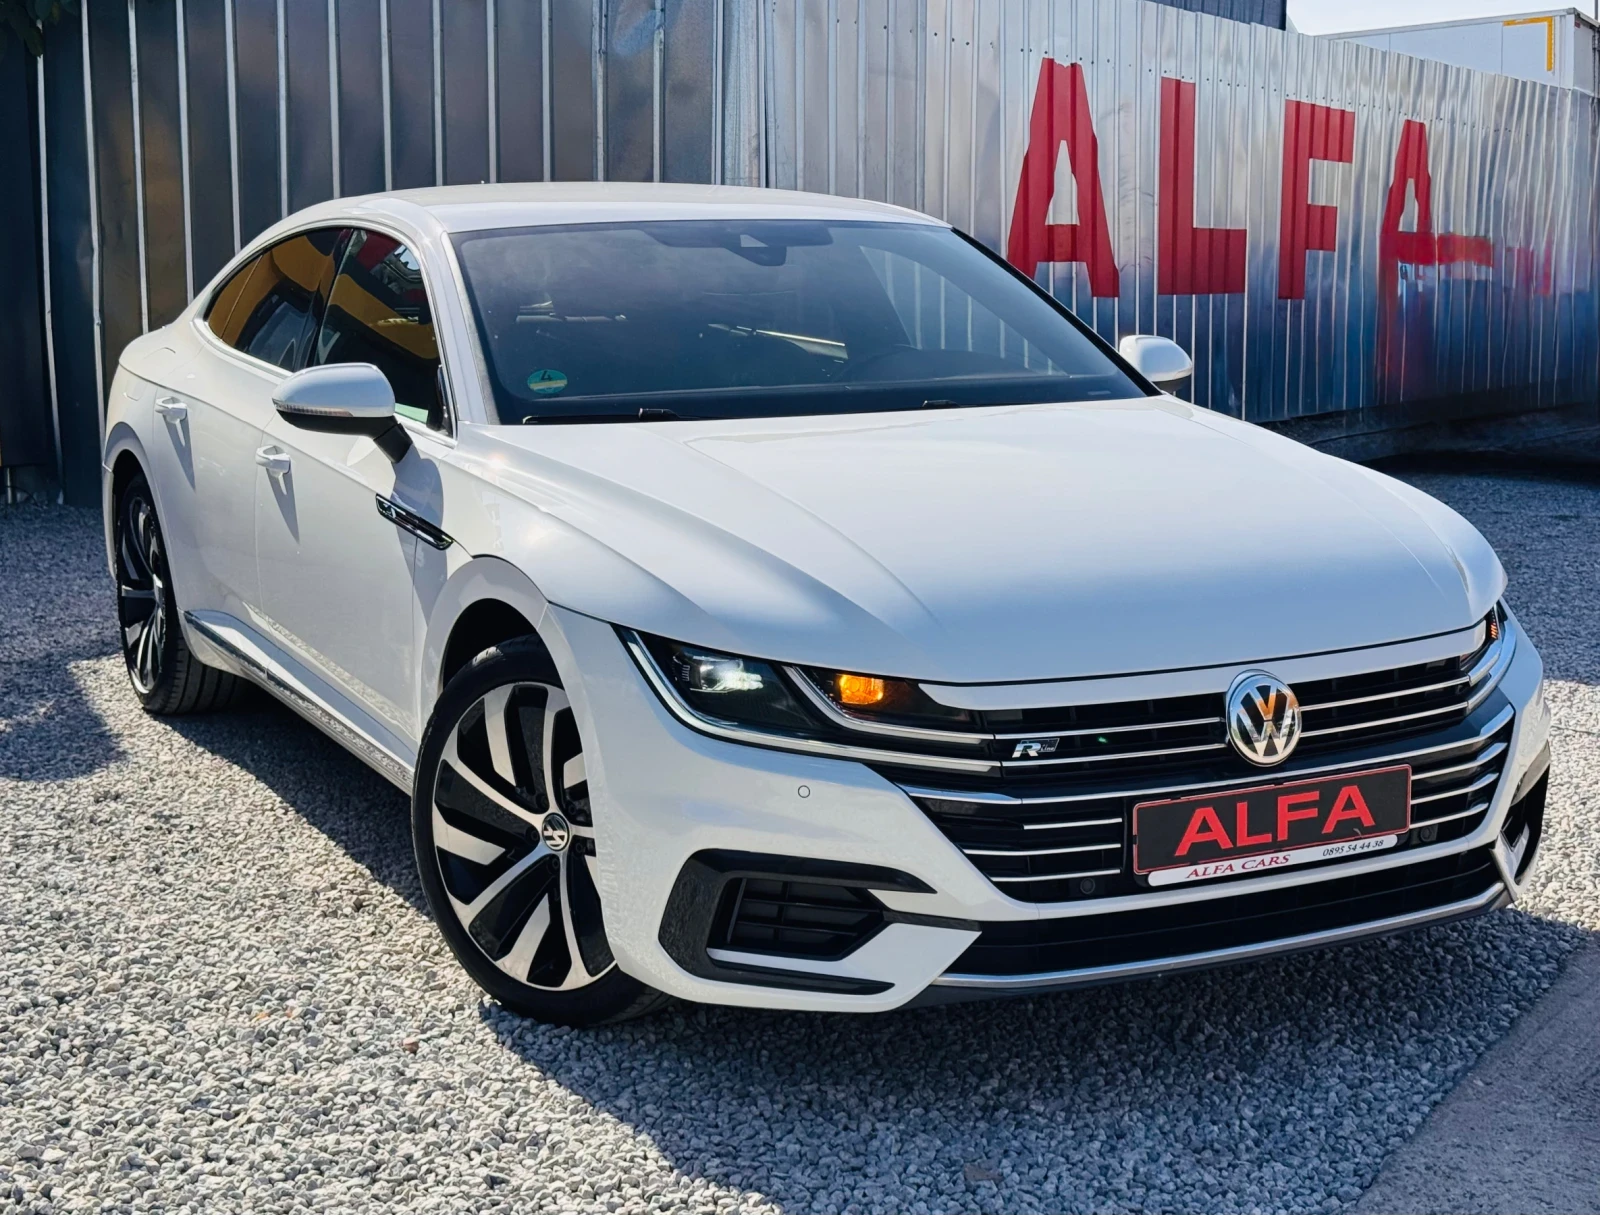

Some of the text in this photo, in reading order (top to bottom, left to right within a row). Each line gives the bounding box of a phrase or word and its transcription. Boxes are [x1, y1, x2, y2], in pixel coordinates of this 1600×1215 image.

[1007, 57, 1440, 300] ALFA
[1174, 784, 1376, 857] ALFA
[1185, 854, 1291, 879] ALFA CARS
[1322, 839, 1384, 857] 0895 54 44 38
